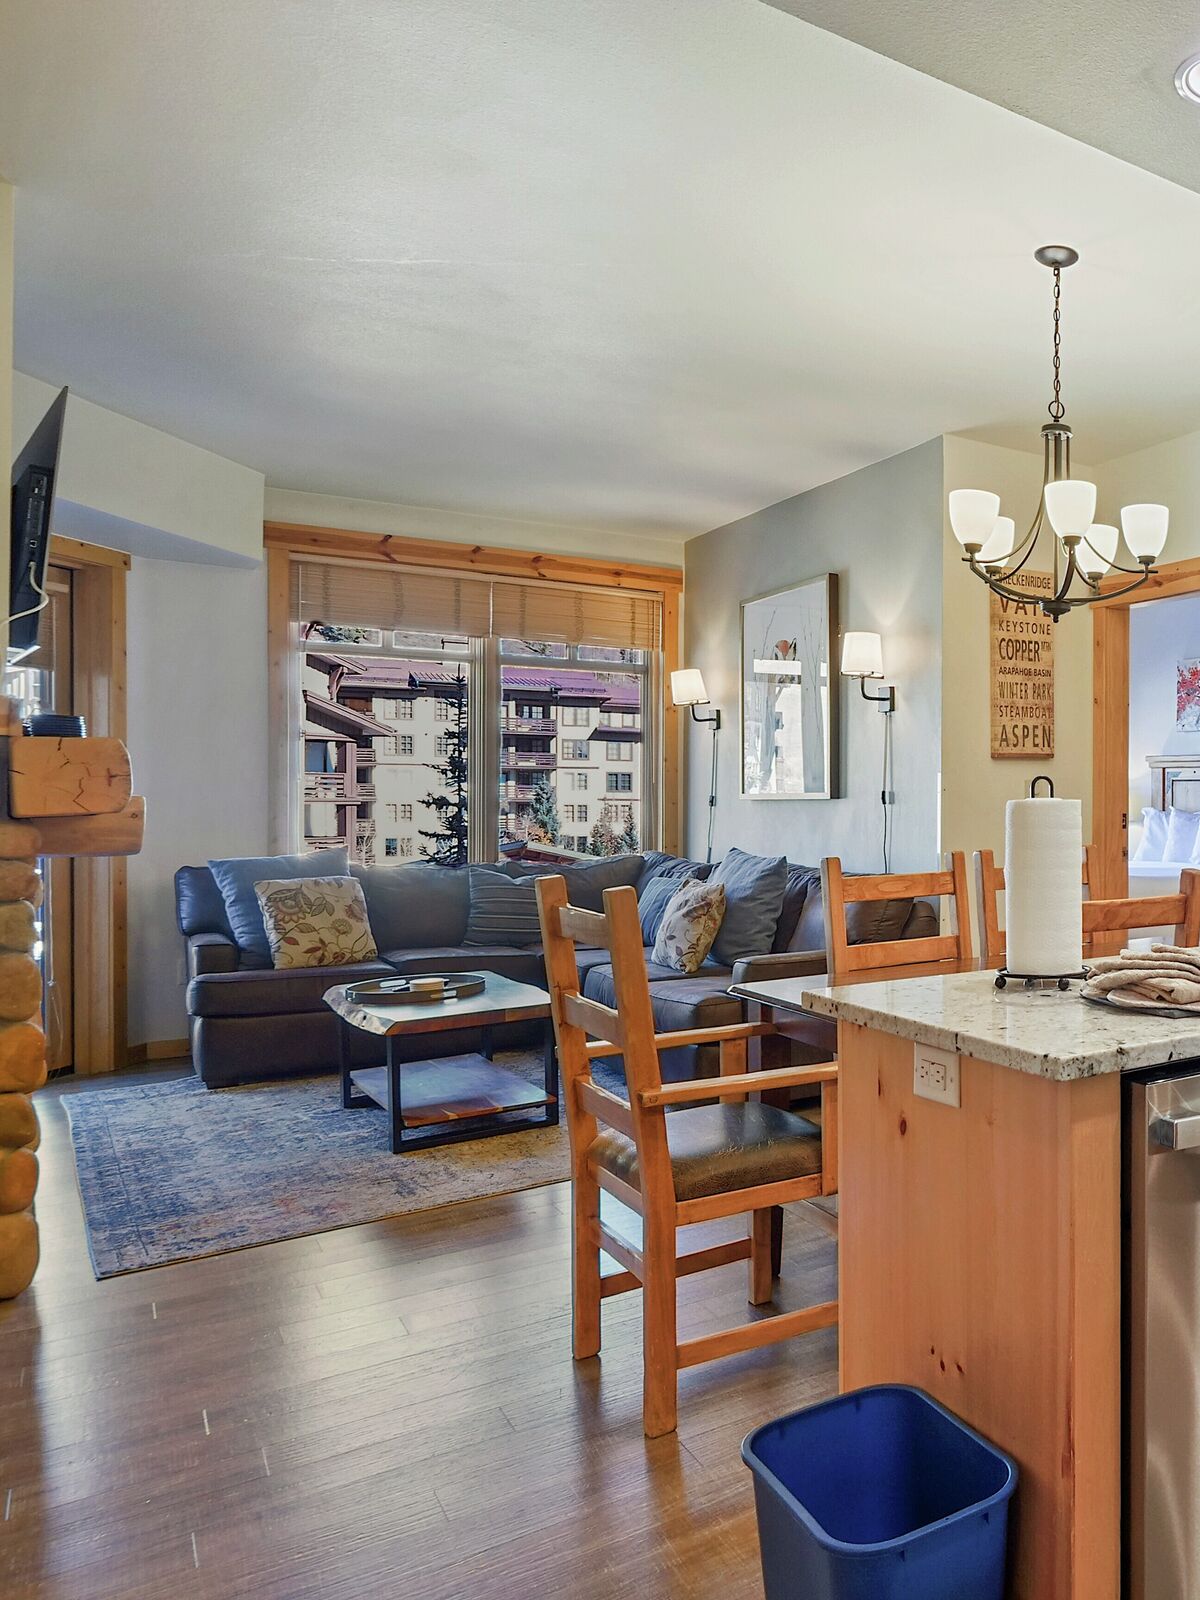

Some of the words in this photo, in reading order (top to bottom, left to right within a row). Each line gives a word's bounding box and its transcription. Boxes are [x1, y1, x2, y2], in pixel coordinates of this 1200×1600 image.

[1000, 596, 1051, 617] VAI
[998, 619, 1051, 635] KEYSTONE
[998, 637, 1040, 662] COPPER
[998, 666, 1032, 676] ARAPAHOE
[1033, 668, 1051, 677] BASIN
[998, 681, 1029, 699] WINTER
[1032, 682, 1051, 700] PARK
[999, 704, 1051, 719] STEAMBOAT
[999, 724, 1051, 748] ASPEN
